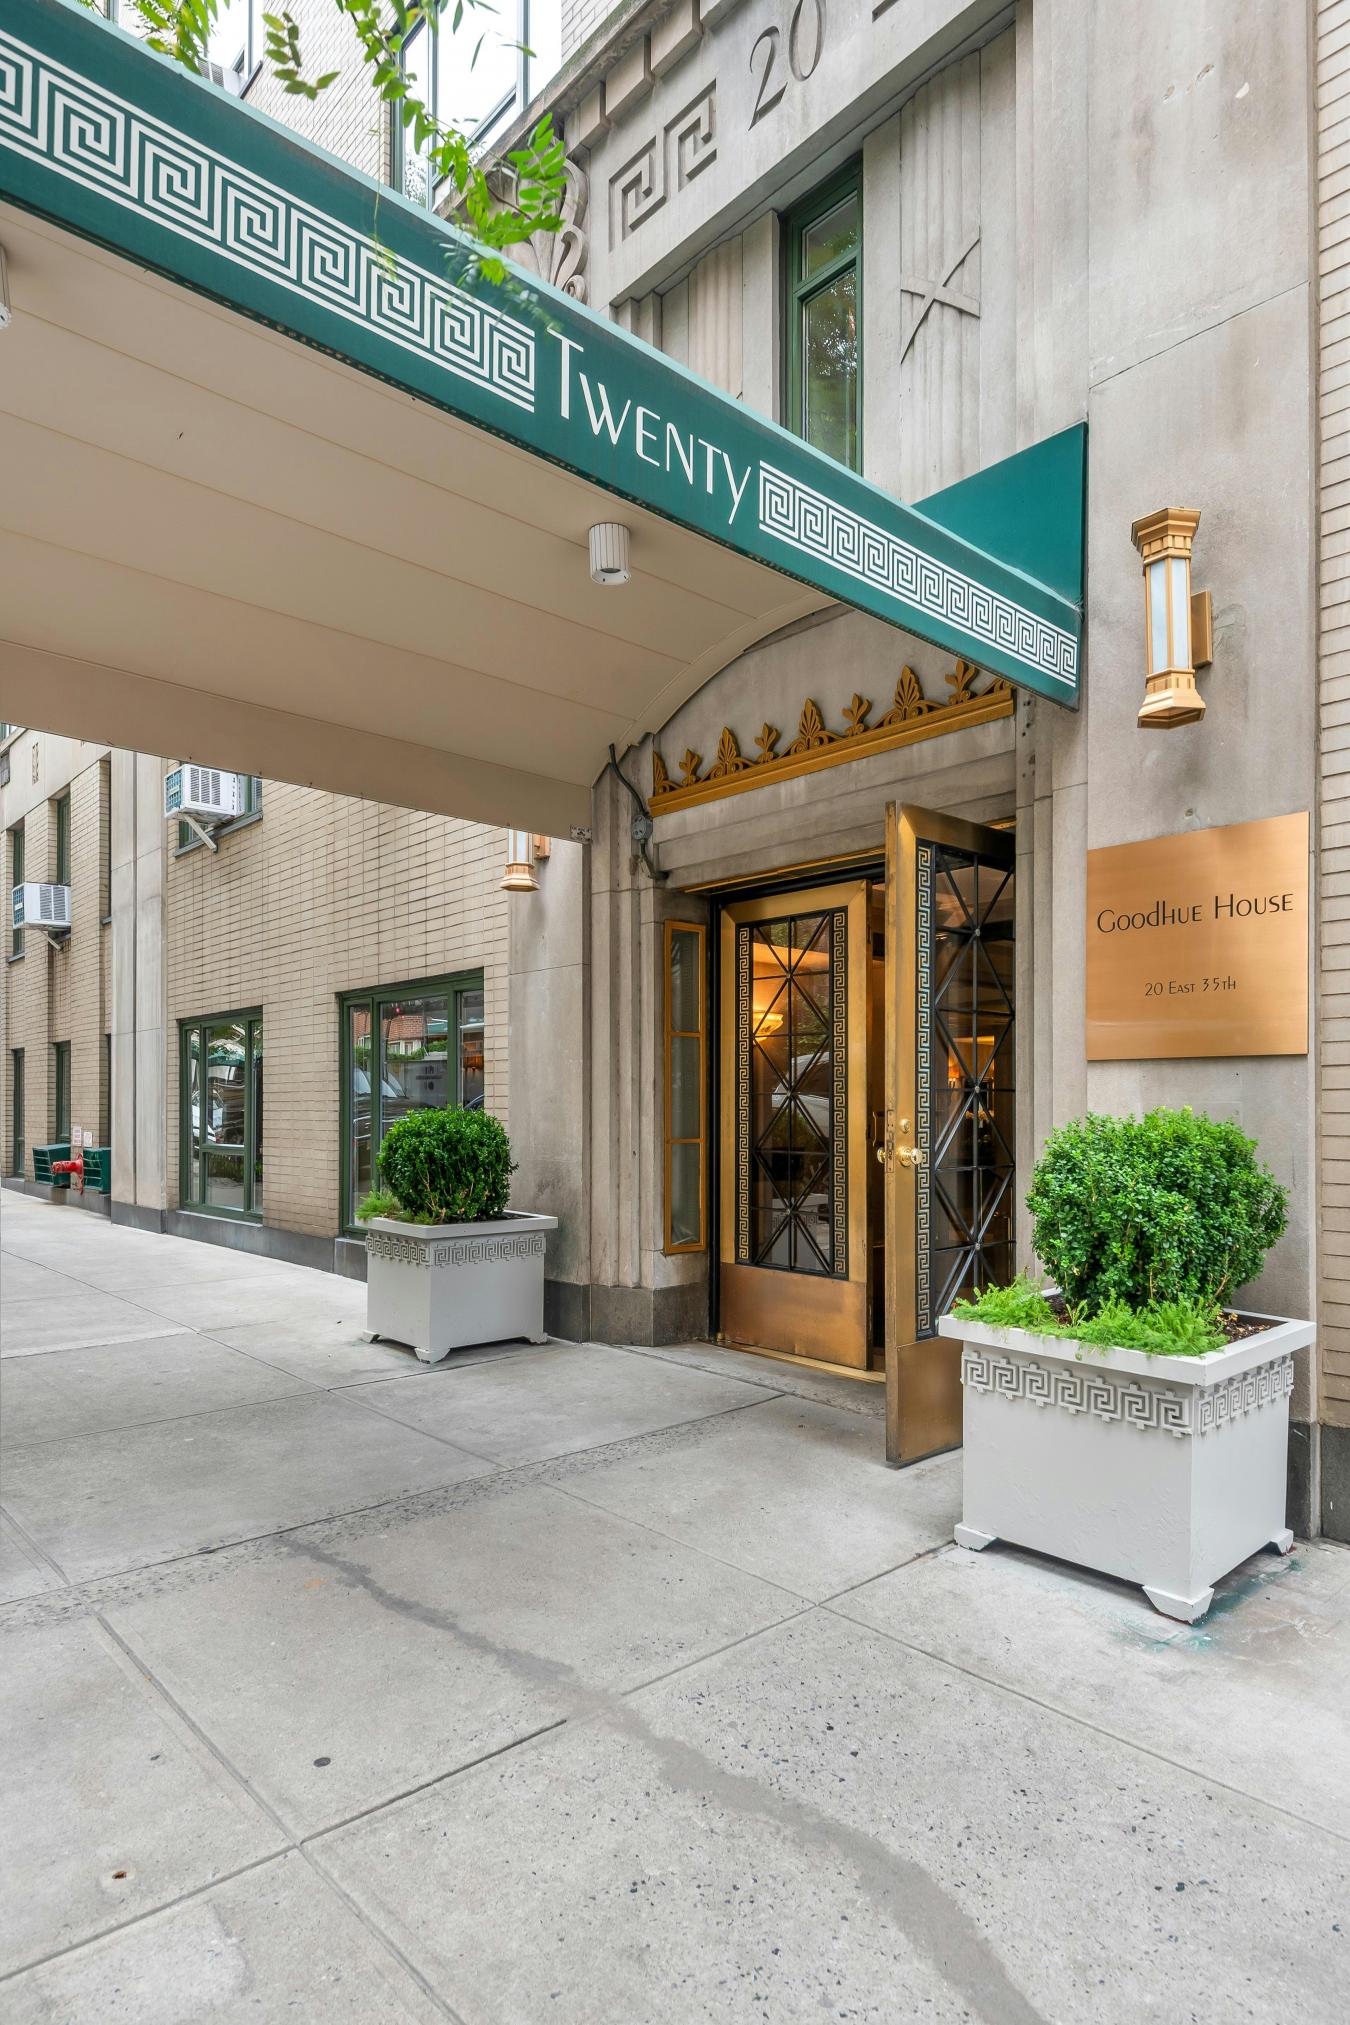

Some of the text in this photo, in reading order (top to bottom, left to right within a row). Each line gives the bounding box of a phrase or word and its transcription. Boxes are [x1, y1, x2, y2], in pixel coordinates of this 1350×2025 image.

[748, 0, 827, 131] 20
[547, 325, 751, 525] TWENTY
[1215, 893, 1294, 919] HOUSE
[1145, 975, 1236, 996] 20 EAST 35TH
